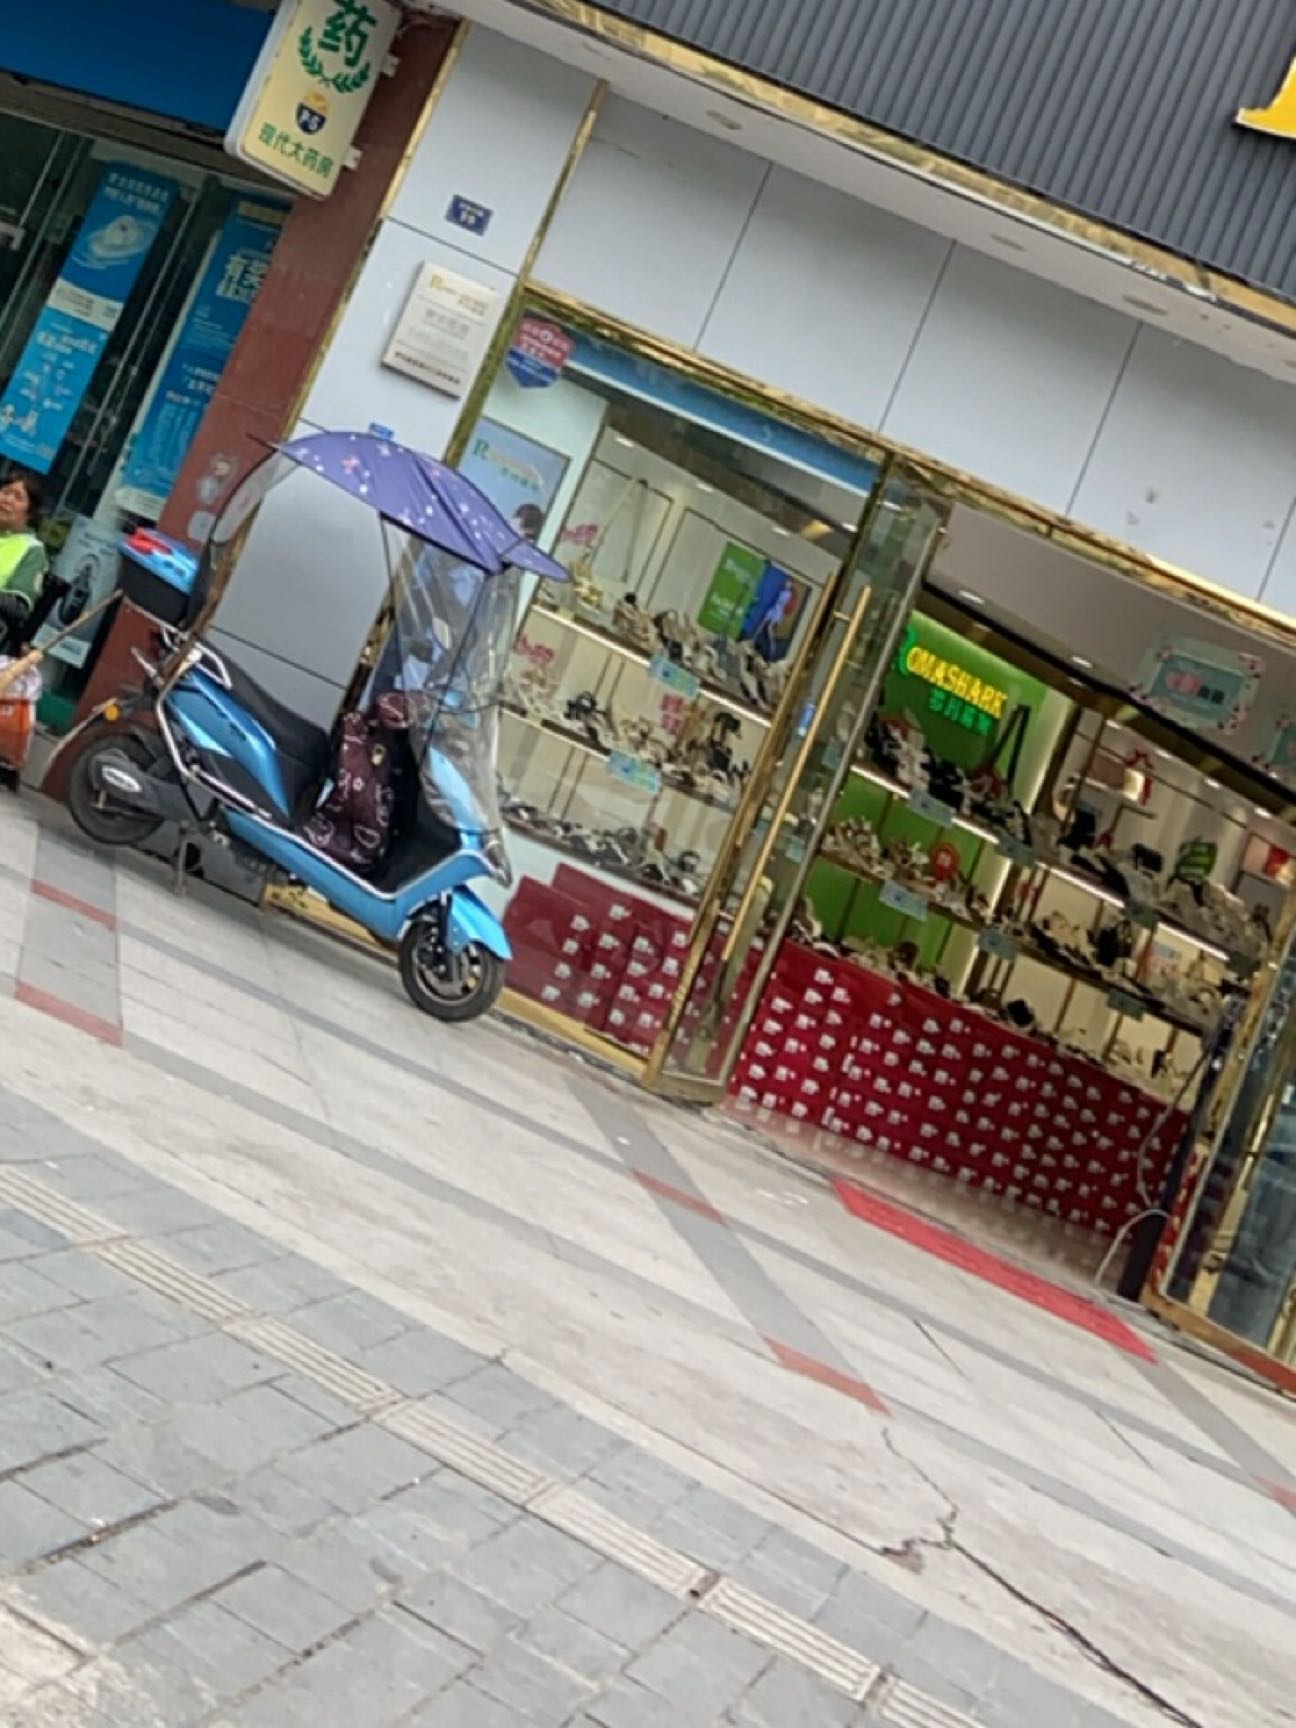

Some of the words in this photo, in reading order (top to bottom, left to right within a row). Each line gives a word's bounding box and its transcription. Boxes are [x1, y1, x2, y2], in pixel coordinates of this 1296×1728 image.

[258, 123, 334, 179] 现代大药房
